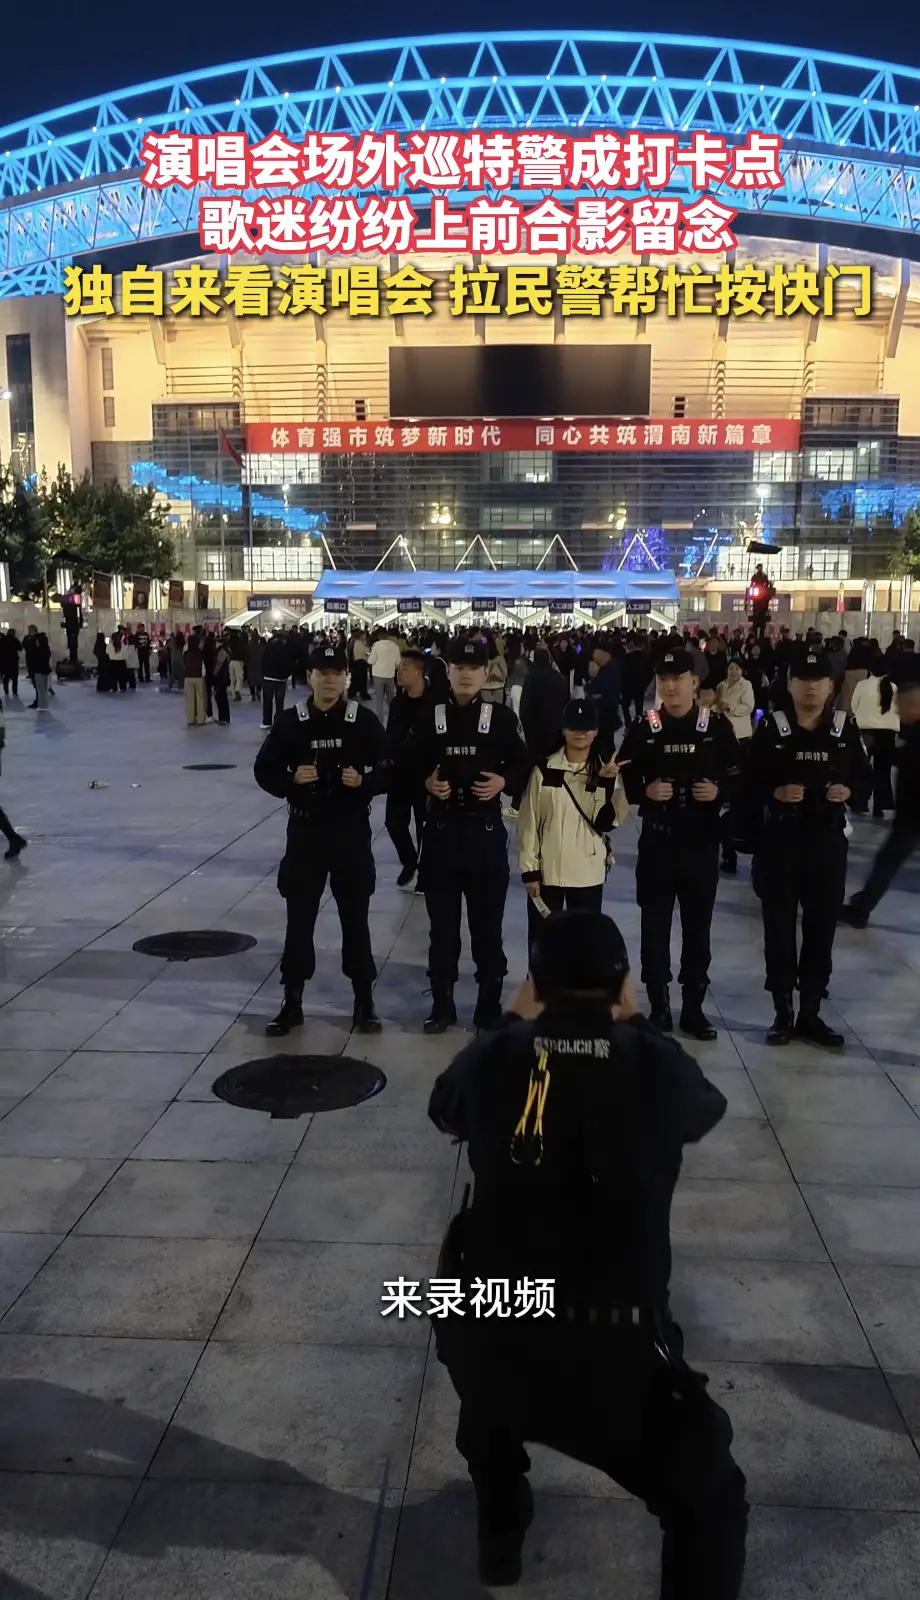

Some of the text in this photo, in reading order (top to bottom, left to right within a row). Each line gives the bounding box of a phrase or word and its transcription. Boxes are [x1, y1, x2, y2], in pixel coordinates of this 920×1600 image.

[271, 423, 772, 449] 体育强市筑梦新时代 同心共筑渭南新篇章
